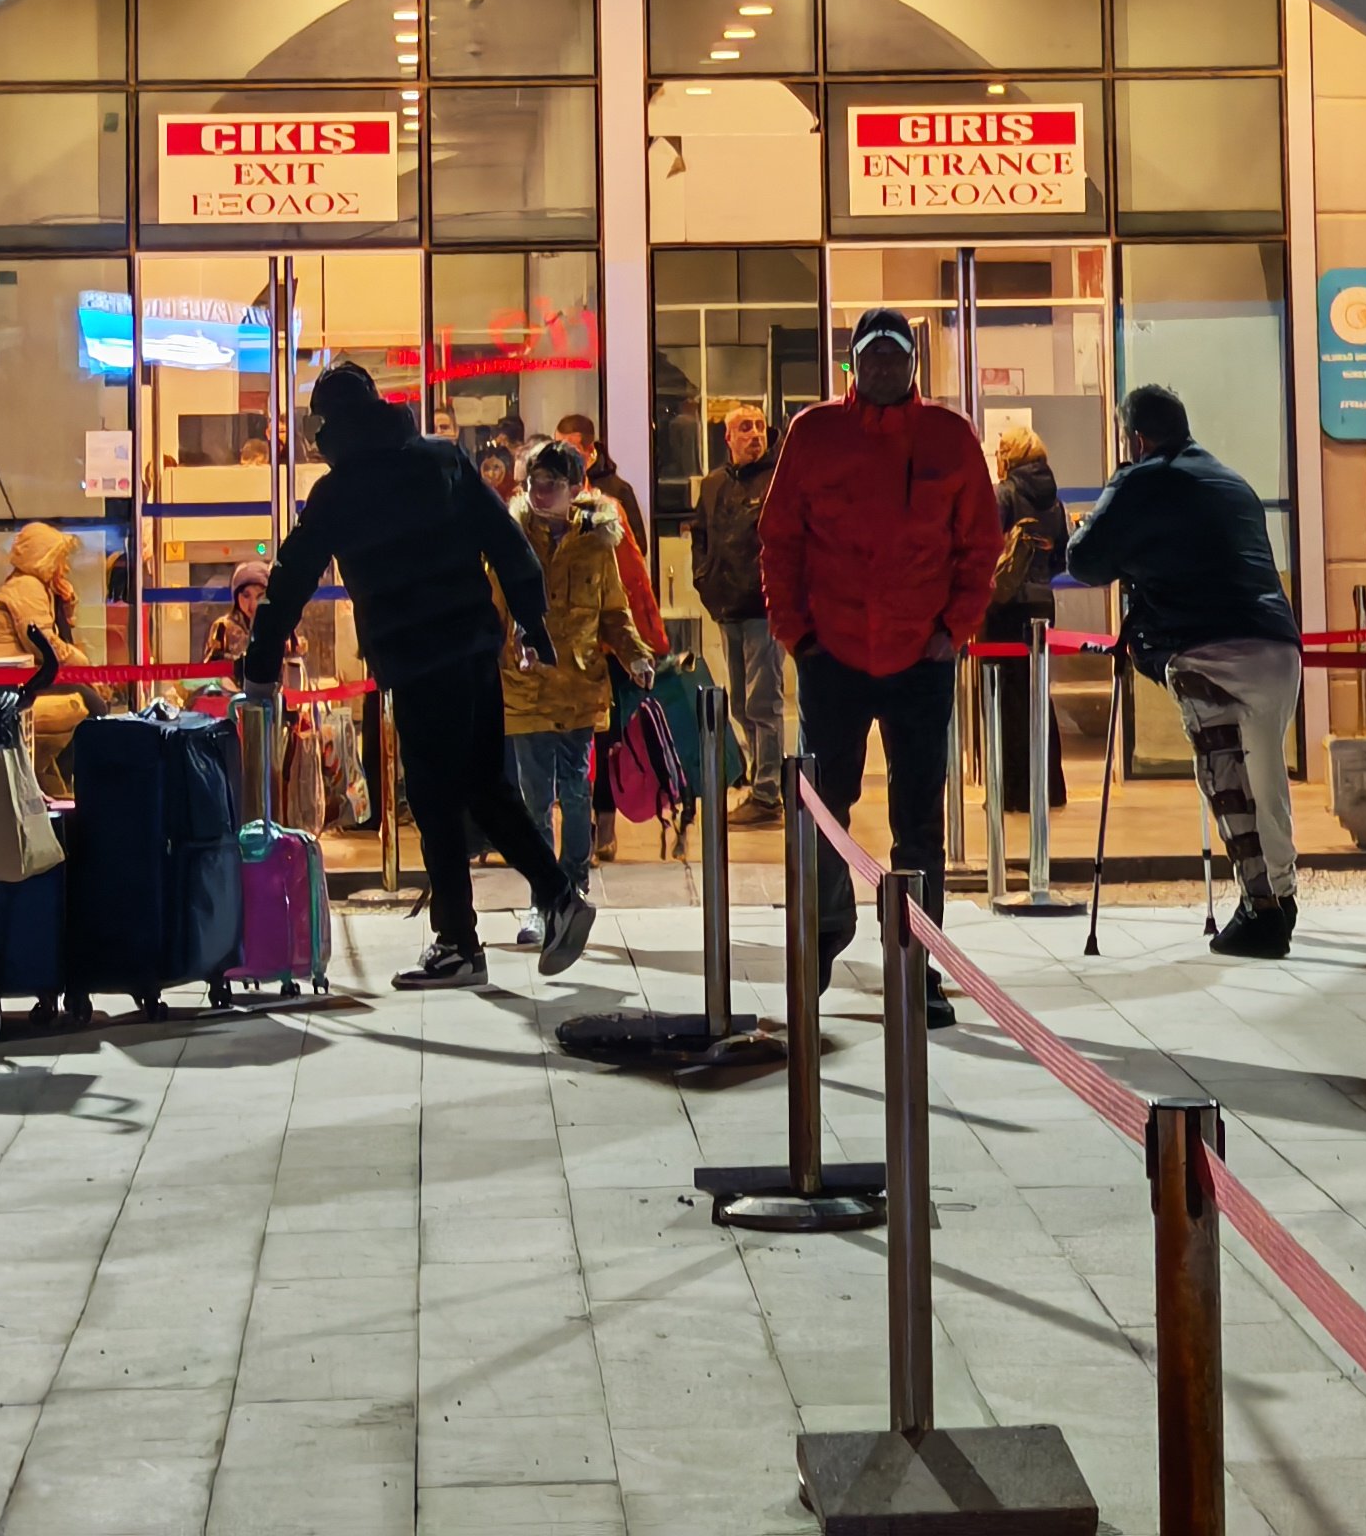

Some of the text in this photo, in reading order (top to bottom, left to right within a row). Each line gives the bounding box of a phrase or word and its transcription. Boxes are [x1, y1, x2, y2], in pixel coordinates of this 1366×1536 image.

[233, 162, 325, 186] EXIT
[862, 151, 1074, 177] ENTRANCE
[192, 192, 360, 216] ΕΞΟΔΟΣ
[881, 183, 1063, 207] ΕΙΣΟΔΟΣ
